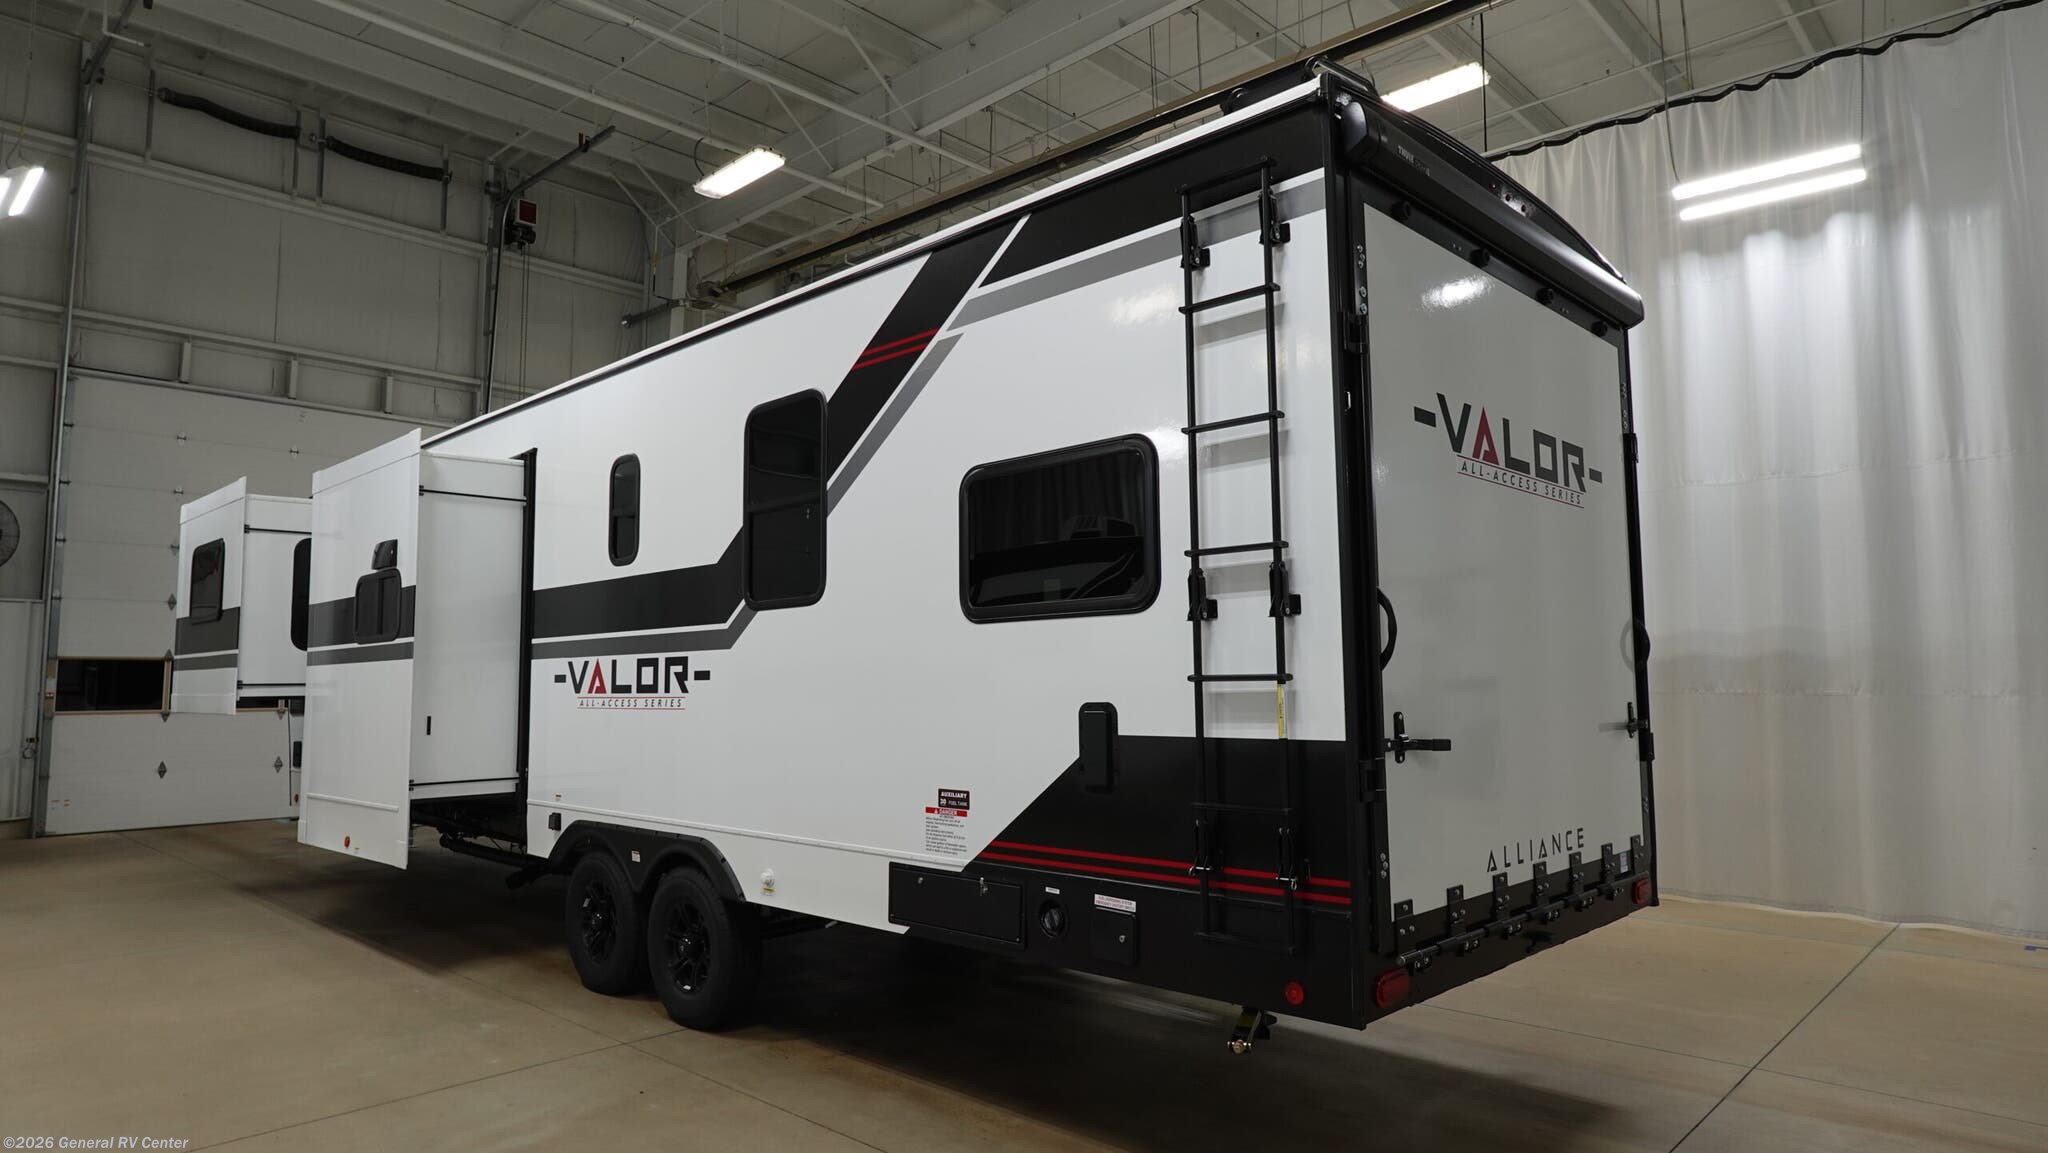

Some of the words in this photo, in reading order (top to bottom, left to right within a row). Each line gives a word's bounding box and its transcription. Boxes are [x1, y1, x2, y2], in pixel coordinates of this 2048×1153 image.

[1461, 461, 1538, 492] ALL-ACCESS
[1544, 485, 1582, 505] SERIES
[579, 699, 638, 708] ALL-ACCESS
[644, 698, 682, 708] SERIES
[940, 791, 967, 799] AUXILIARY
[1487, 827, 1584, 872] ALLIANCE
